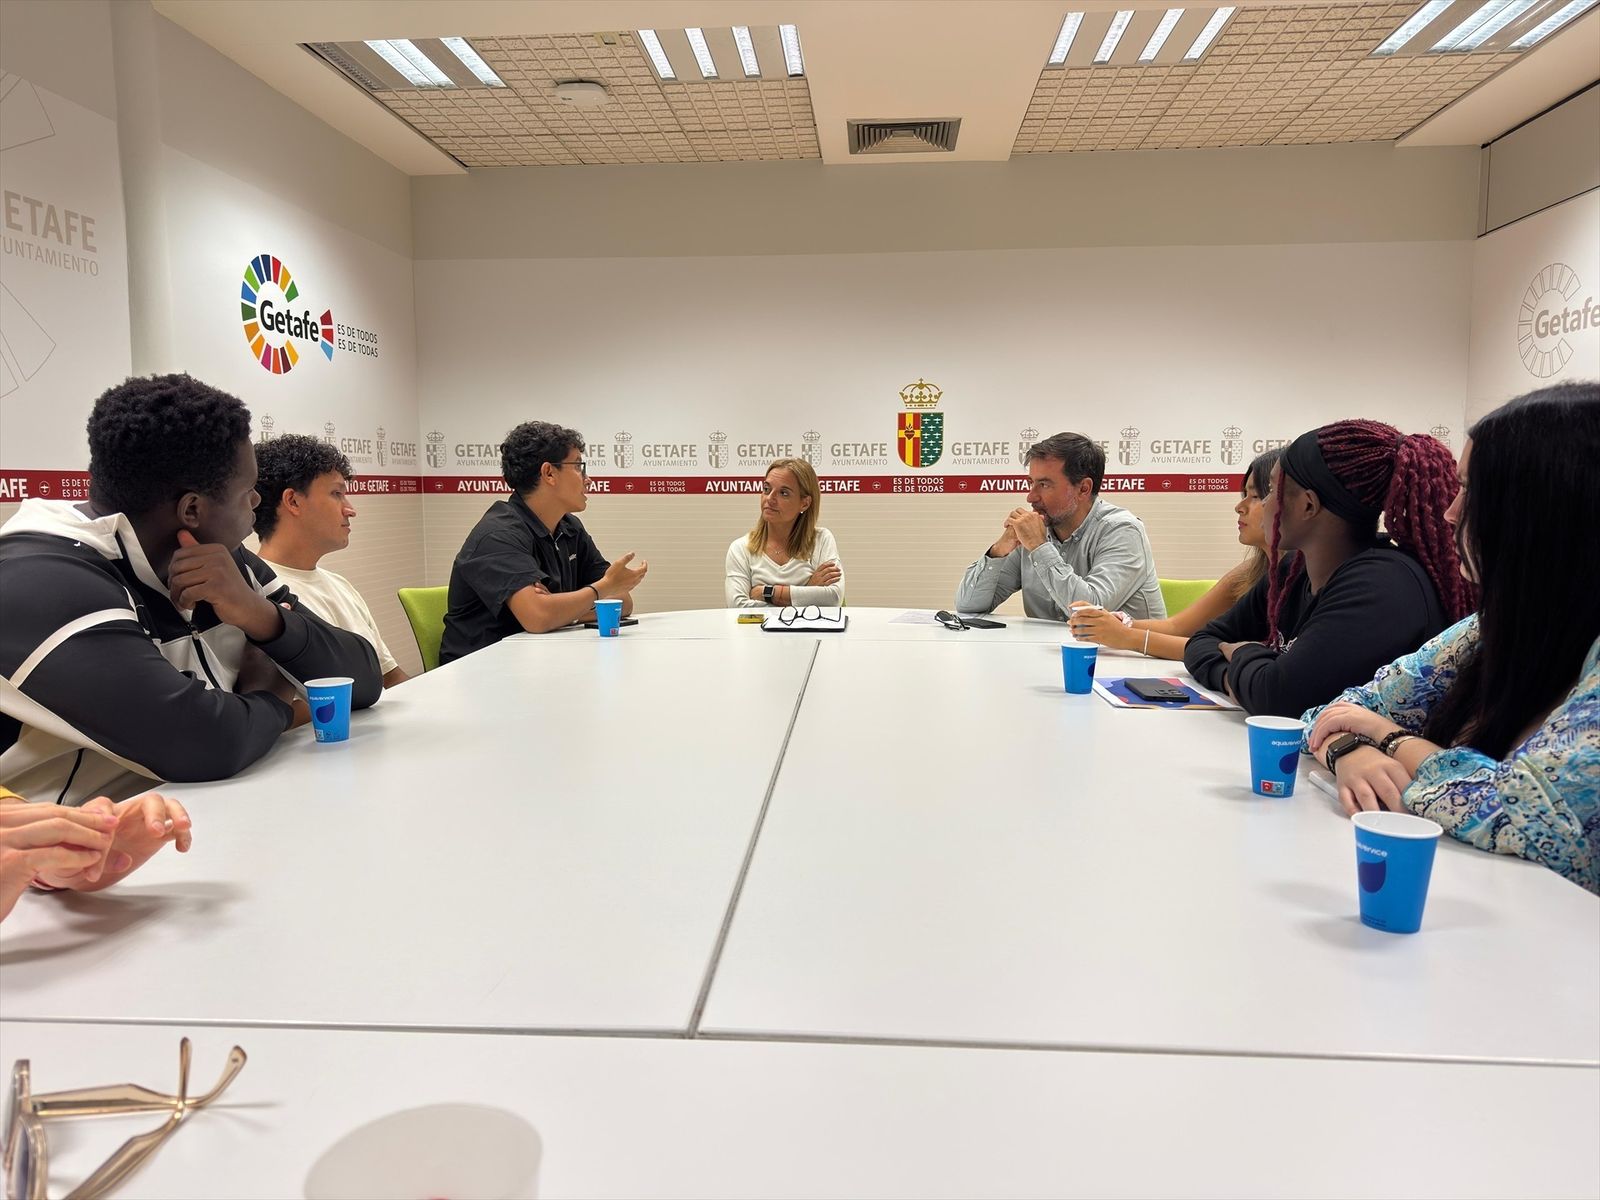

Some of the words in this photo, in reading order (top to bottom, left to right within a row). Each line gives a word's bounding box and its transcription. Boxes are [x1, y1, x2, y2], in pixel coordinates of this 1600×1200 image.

[4, 190, 97, 253] ETAFE
[0, 234, 99, 277] UNTAMIENTO
[260, 300, 319, 342] Getafe
[1535, 296, 1600, 339] Getafe
[337, 324, 345, 335] ES
[347, 326, 355, 338] DE
[357, 329, 377, 344] TODOS
[338, 339, 346, 350] ES
[348, 341, 356, 352] DE
[358, 343, 378, 357] TODAS
[341, 438, 372, 454] GETAFE
[390, 442, 417, 457] GETAFE
[455, 444, 502, 457] GETAF
[641, 444, 697, 458] GETAFE
[737, 443, 793, 457] GETAFE
[831, 443, 887, 457] GETAFE
[951, 442, 1009, 456] GETAFE
[1150, 440, 1212, 454] GETAFE
[643, 459, 698, 467] AYUNTAMIENTO
[831, 458, 888, 466] AYUNTAMIENTO
[952, 457, 1010, 465] AYUNTAMIENTO
[1151, 456, 1212, 464] AYUNTAMIENTO
[0, 478, 29, 498] AFE
[61, 478, 70, 487] ES
[71, 478, 81, 487] DE
[367, 480, 389, 492] GETAFE
[705, 480, 764, 492] AYUNTAM
[893, 477, 903, 485] ES
[904, 477, 915, 485] DE
[916, 477, 944, 485] TODOS
[979, 479, 1030, 491] AYUNTA
[62, 488, 71, 498] ES
[72, 488, 82, 498] DE
[893, 485, 903, 493] ES
[904, 485, 915, 493] DE
[917, 485, 944, 493] TODAS
